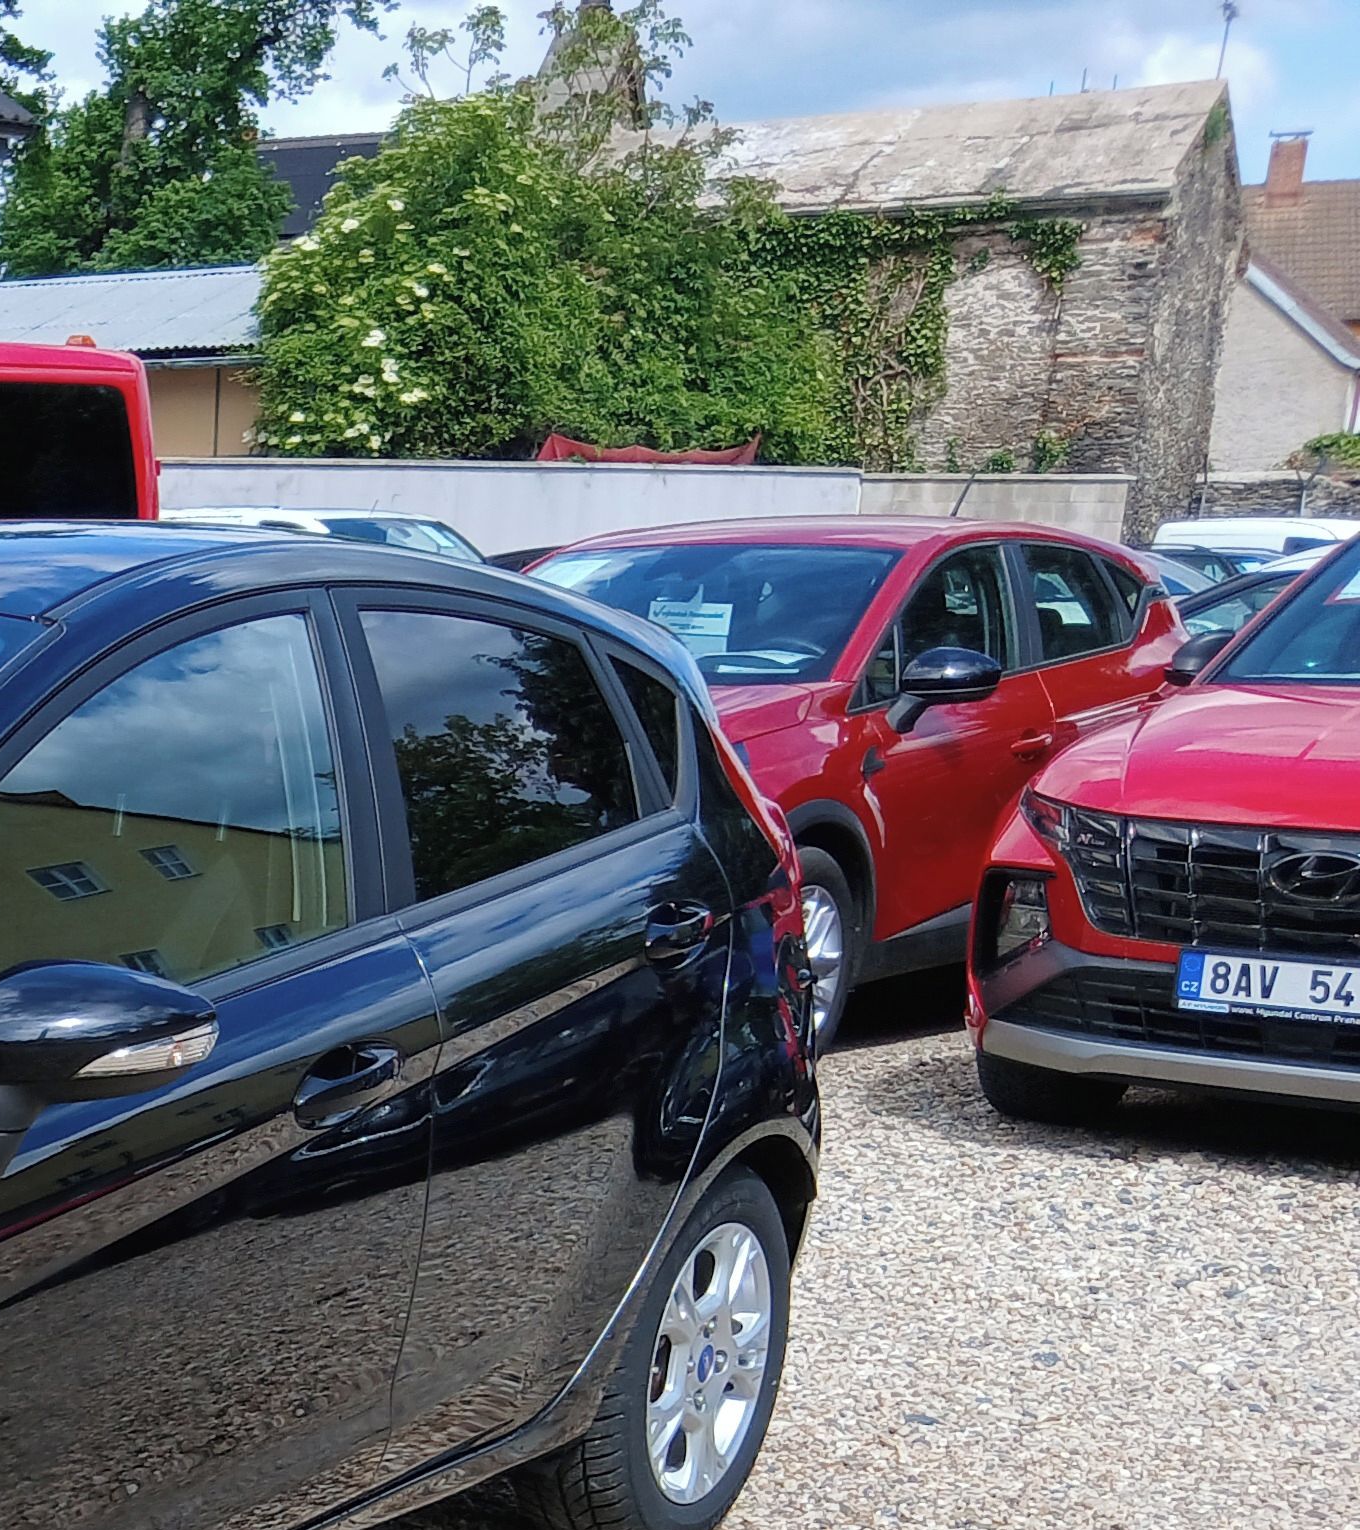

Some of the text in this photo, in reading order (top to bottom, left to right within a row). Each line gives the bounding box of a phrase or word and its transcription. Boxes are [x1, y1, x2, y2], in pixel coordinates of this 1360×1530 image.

[1181, 981, 1199, 993] CZ
[1209, 961, 1355, 1007] 8AV 54
[1294, 1010, 1333, 1022] Centrum
